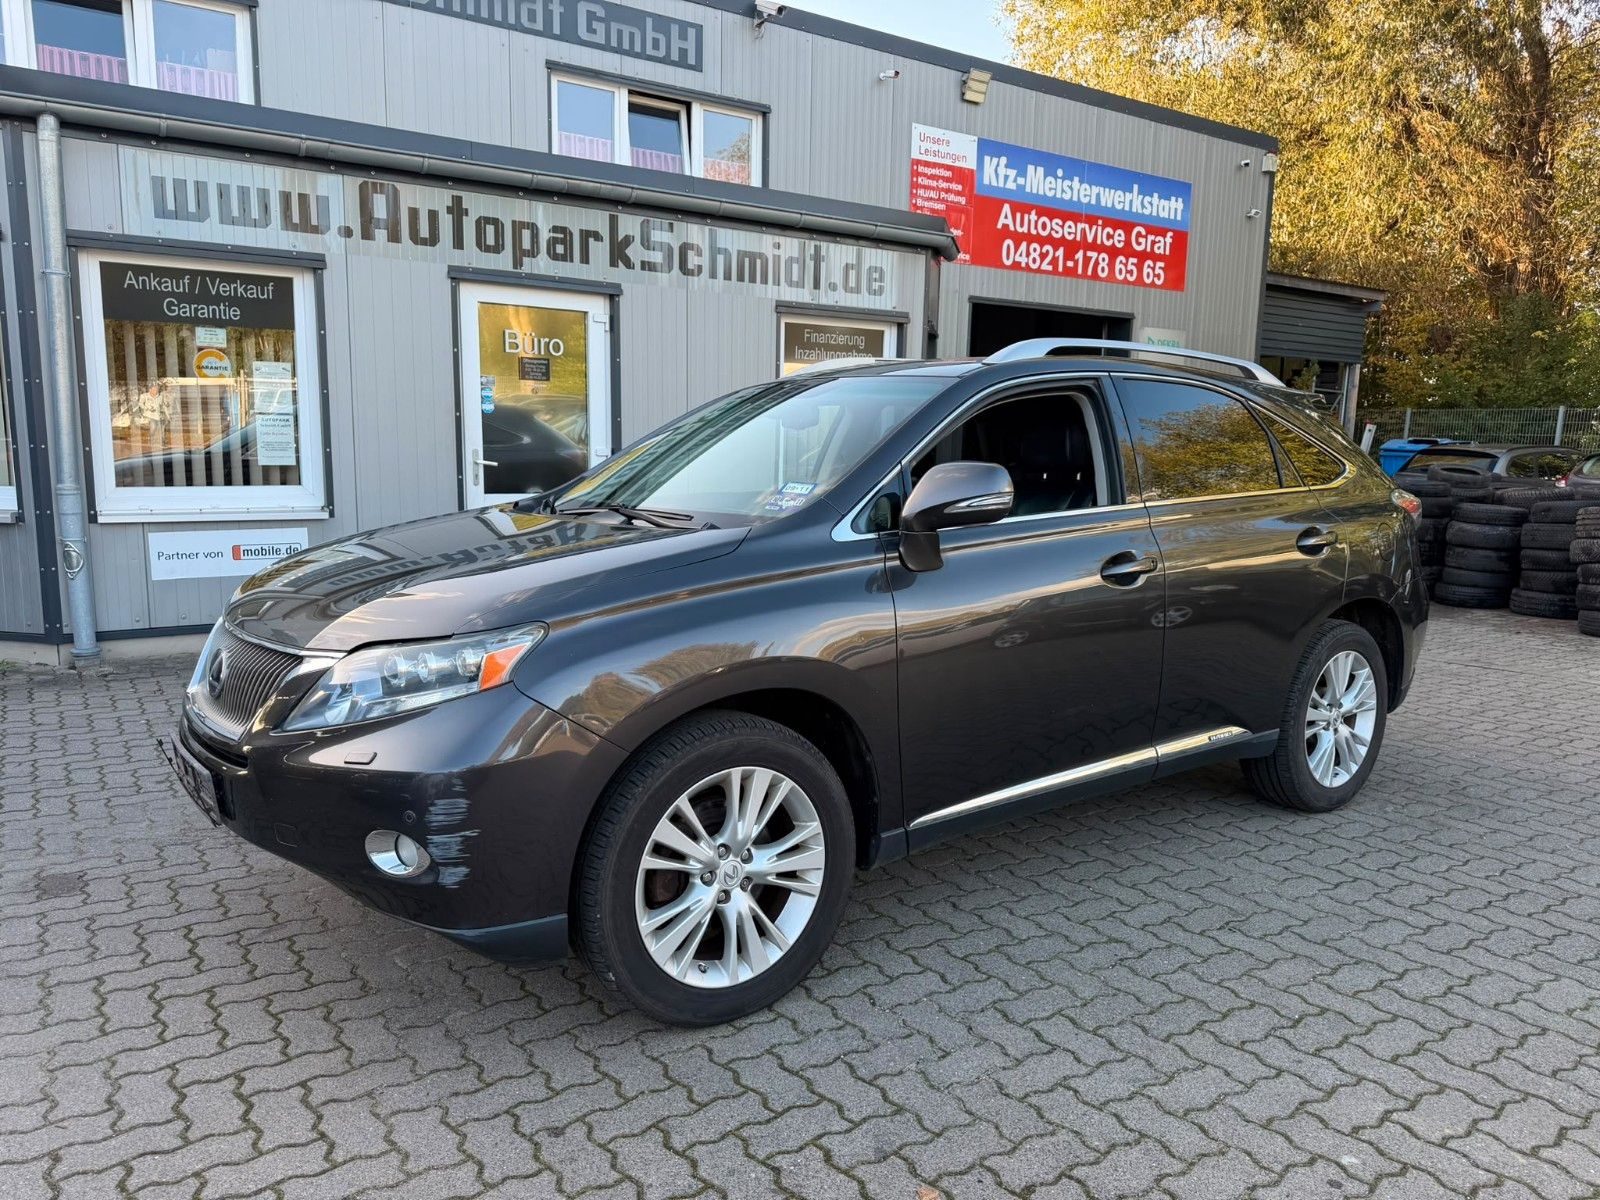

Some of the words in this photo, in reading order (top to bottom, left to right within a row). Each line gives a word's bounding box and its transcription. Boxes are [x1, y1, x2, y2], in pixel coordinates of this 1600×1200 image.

[577, 1, 696, 65] GmbH
[919, 131, 951, 147] Unsere
[919, 145, 968, 164] Leistungen
[917, 164, 953, 178] Inspektion
[917, 176, 963, 191] Klima-Service
[983, 155, 1184, 221] Kfz-Meisterwerkstatt
[916, 198, 946, 211] Bremsen
[917, 188, 939, 199] HU/AU
[940, 191, 966, 205] Prüfung
[151, 175, 886, 297] www.AutoparkSchmidt.de
[996, 202, 1126, 249] Autoservice
[1131, 226, 1174, 256] Graf
[1001, 239, 1109, 277] 04821-178
[1114, 256, 1138, 282] 65
[1143, 259, 1166, 286] 65
[123, 270, 191, 293] Ankauf
[206, 277, 275, 300] Verkauf
[163, 297, 241, 321] Garantie
[503, 328, 565, 357] Büro
[803, 329, 866, 349] Finanzierung
[157, 551, 200, 561] Partner
[202, 550, 224, 559] von
[242, 545, 299, 558] mobile.de
